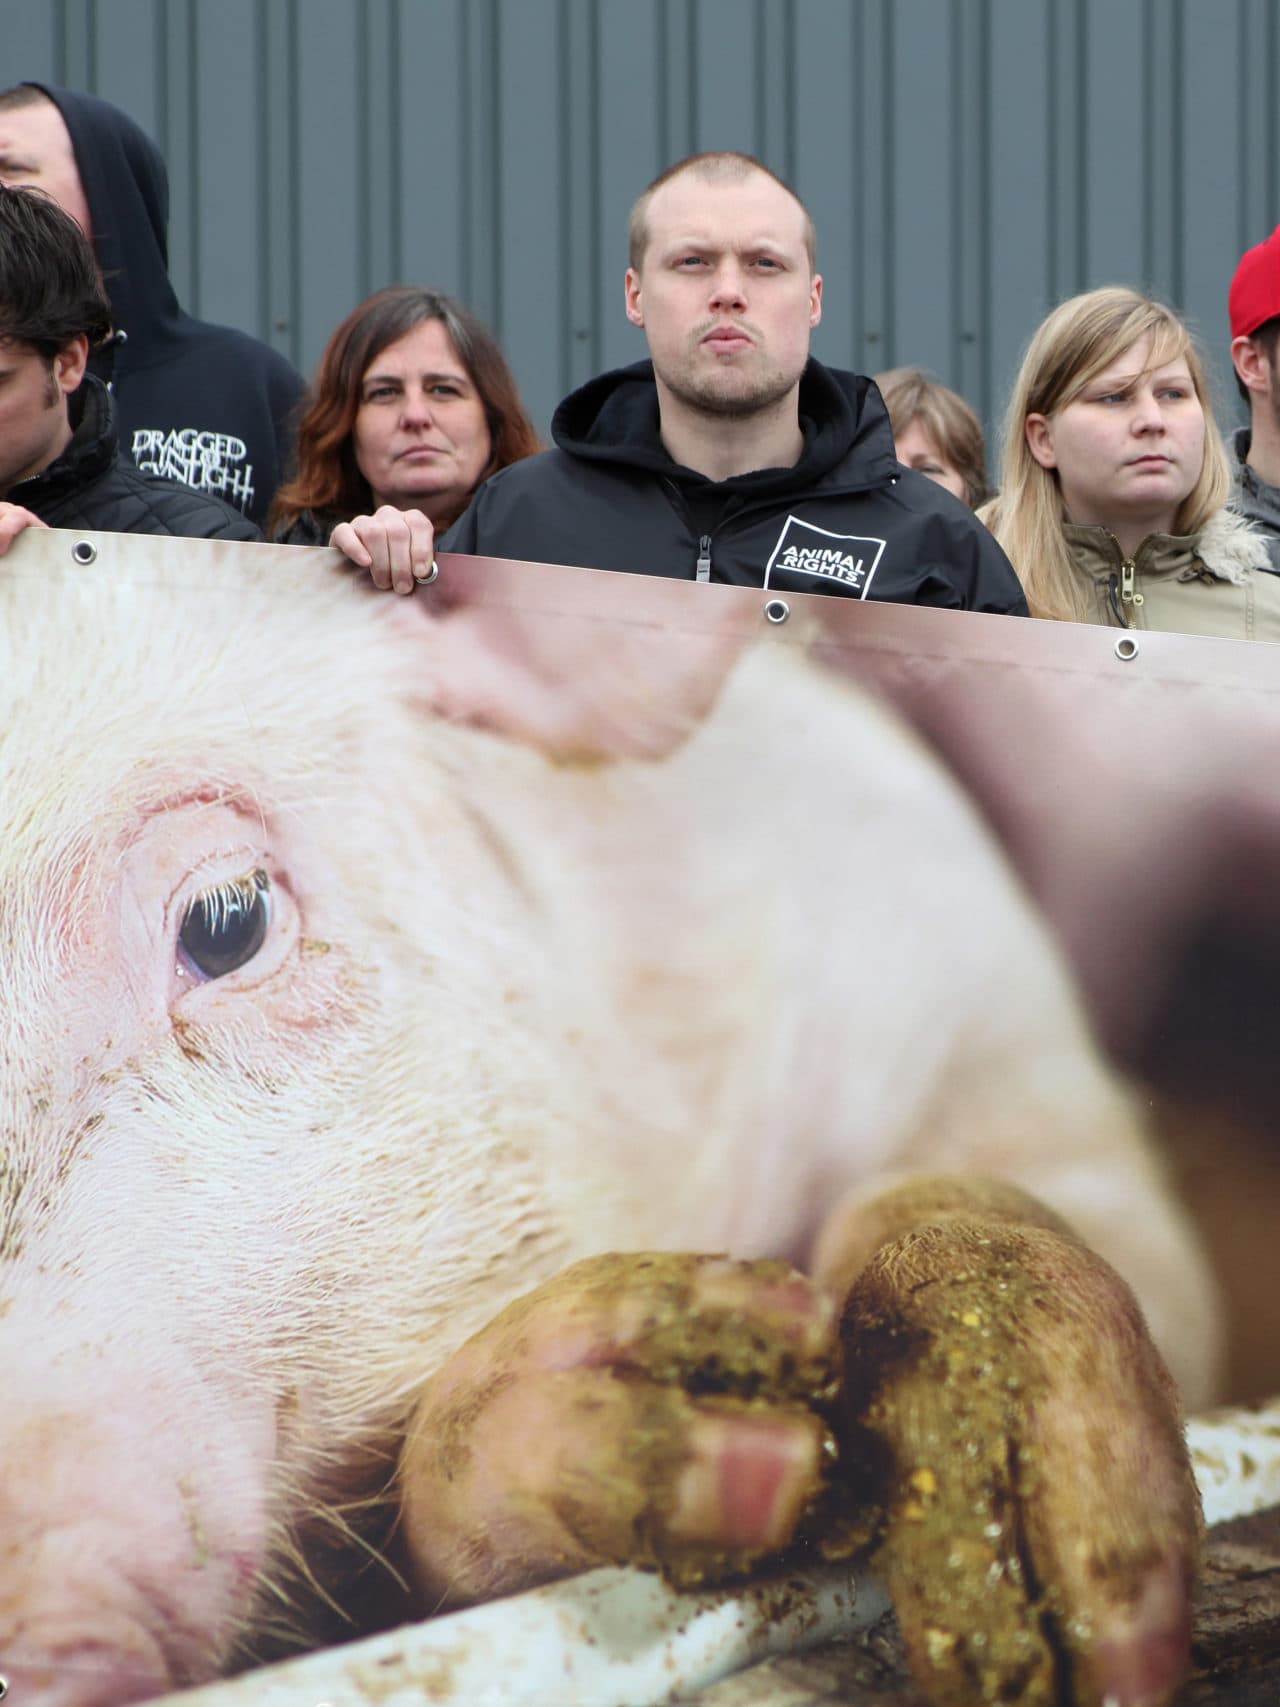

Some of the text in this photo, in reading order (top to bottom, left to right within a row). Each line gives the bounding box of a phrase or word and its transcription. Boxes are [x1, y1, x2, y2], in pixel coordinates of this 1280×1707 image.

[132, 428, 247, 461] DRAGGED
[782, 546, 866, 576] ANIMAL
[783, 555, 858, 582] RIGHTS
